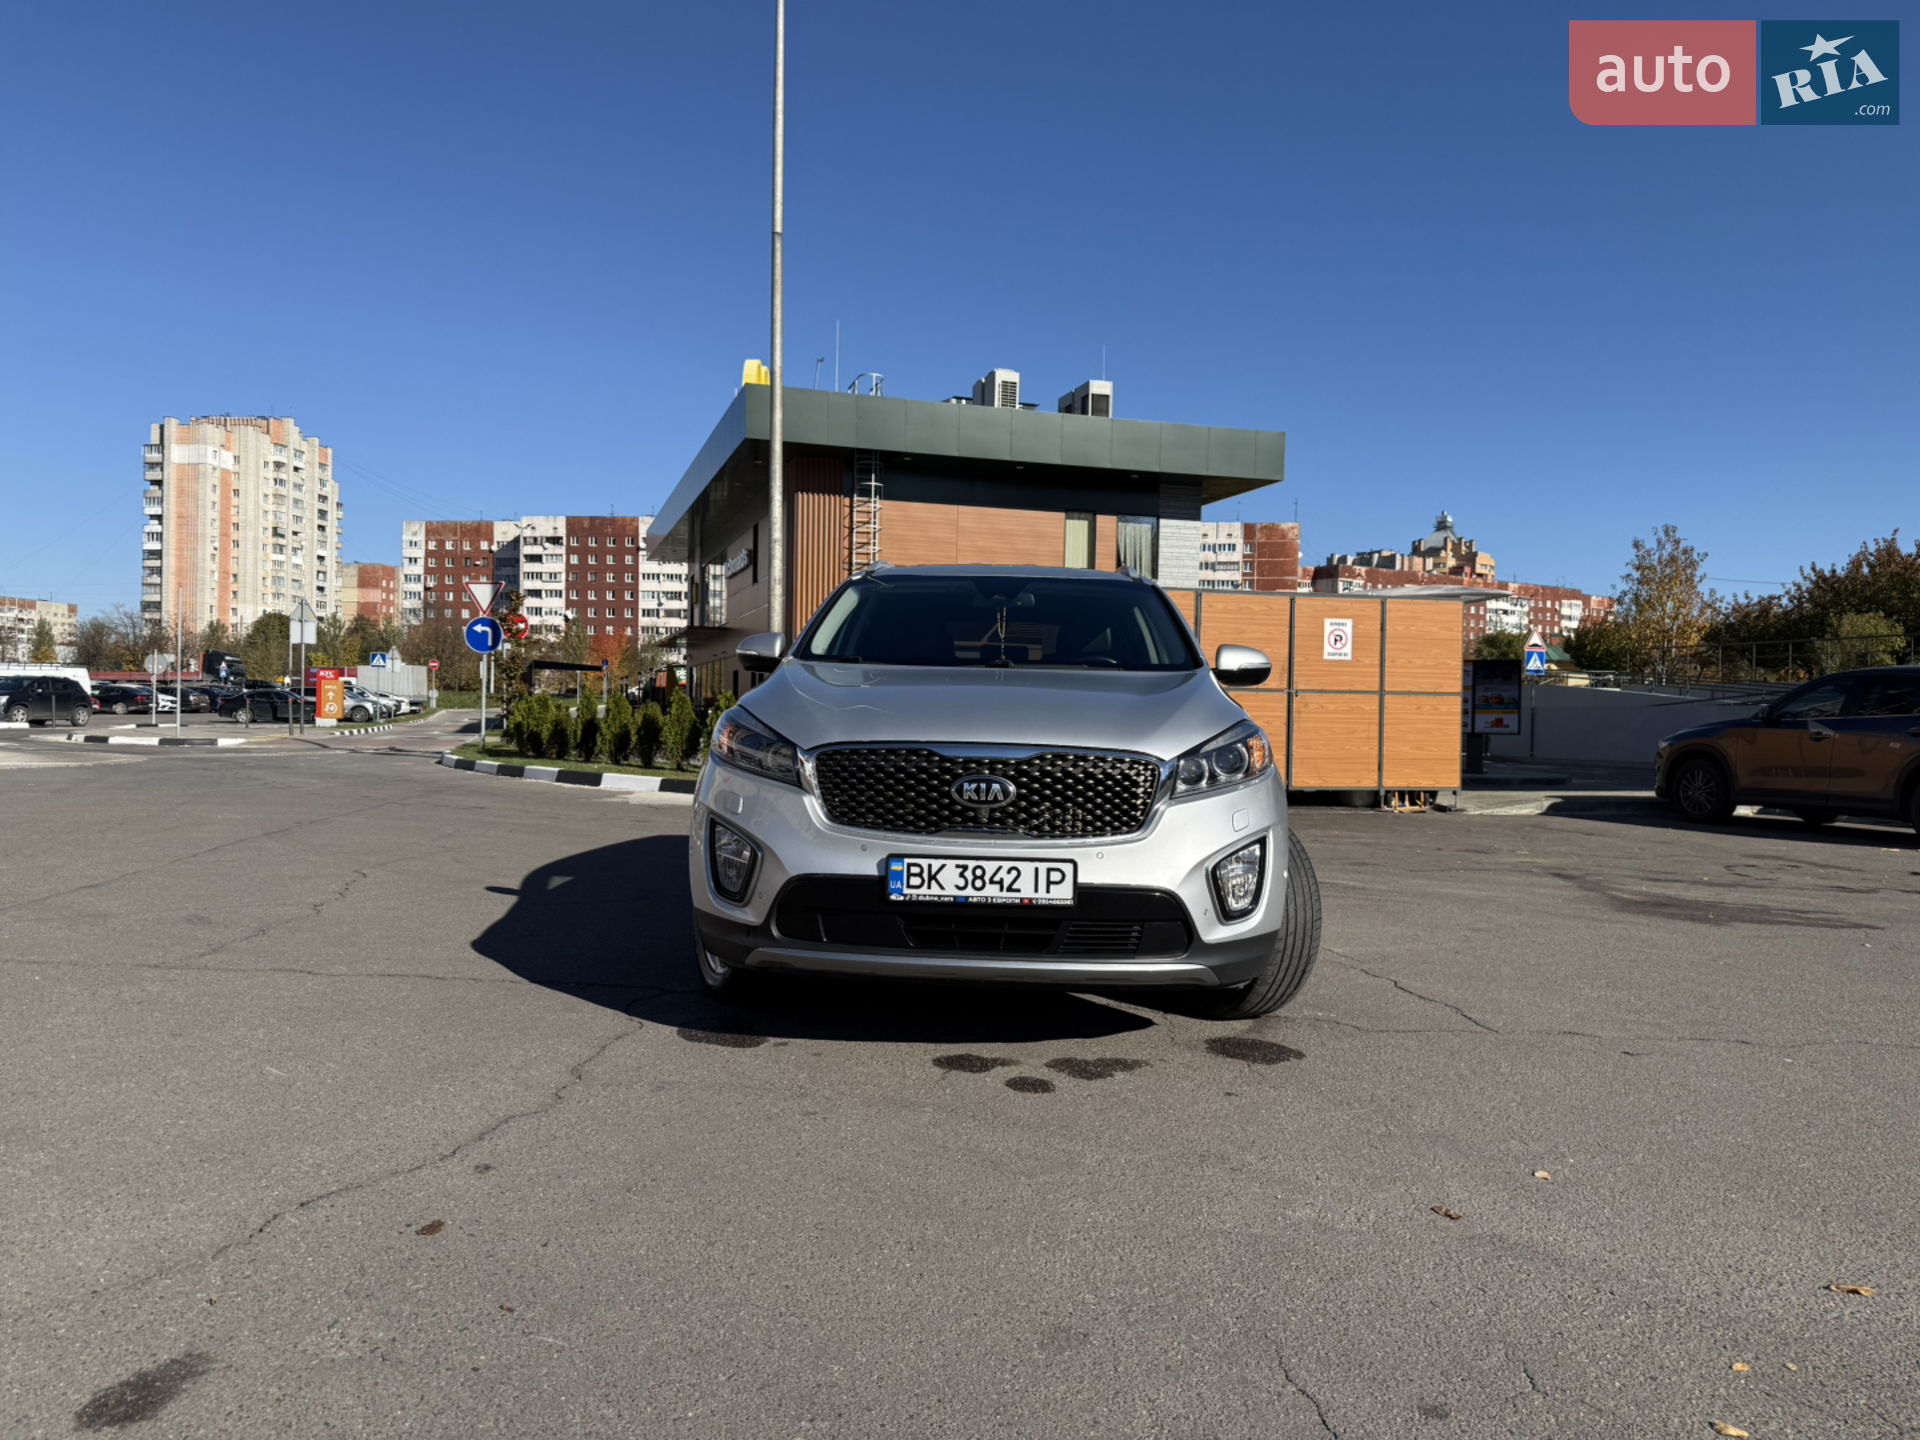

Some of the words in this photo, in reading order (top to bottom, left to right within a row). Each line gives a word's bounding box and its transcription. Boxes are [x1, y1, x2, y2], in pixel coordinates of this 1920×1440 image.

[963, 782, 1005, 801] KIA
[906, 862, 946, 891] BK
[954, 863, 1022, 893] 3842
[1034, 866, 1067, 894] IP
